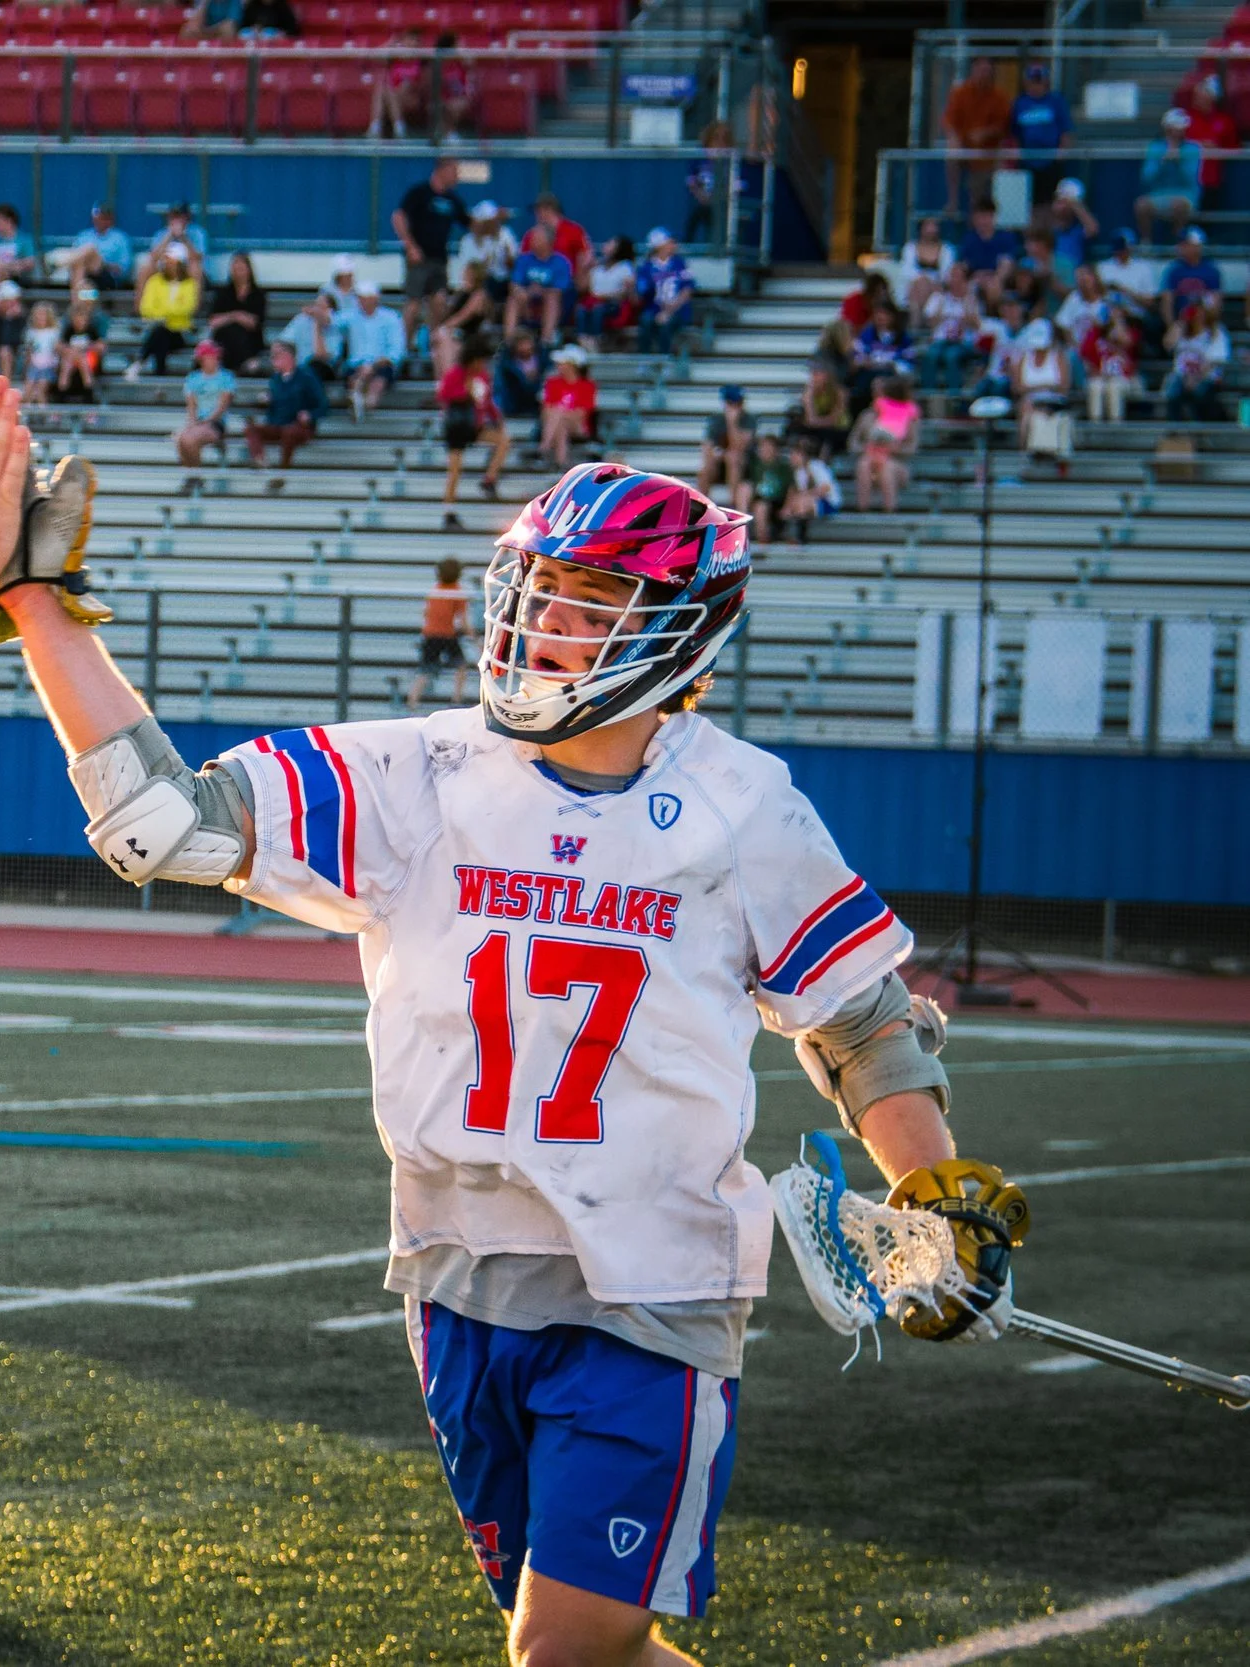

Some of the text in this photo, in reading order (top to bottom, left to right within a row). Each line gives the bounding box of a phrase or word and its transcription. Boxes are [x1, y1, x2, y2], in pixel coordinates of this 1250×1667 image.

[550, 833, 588, 865] W
[453, 864, 681, 941] WESTLAKE
[463, 929, 651, 1144] 17
